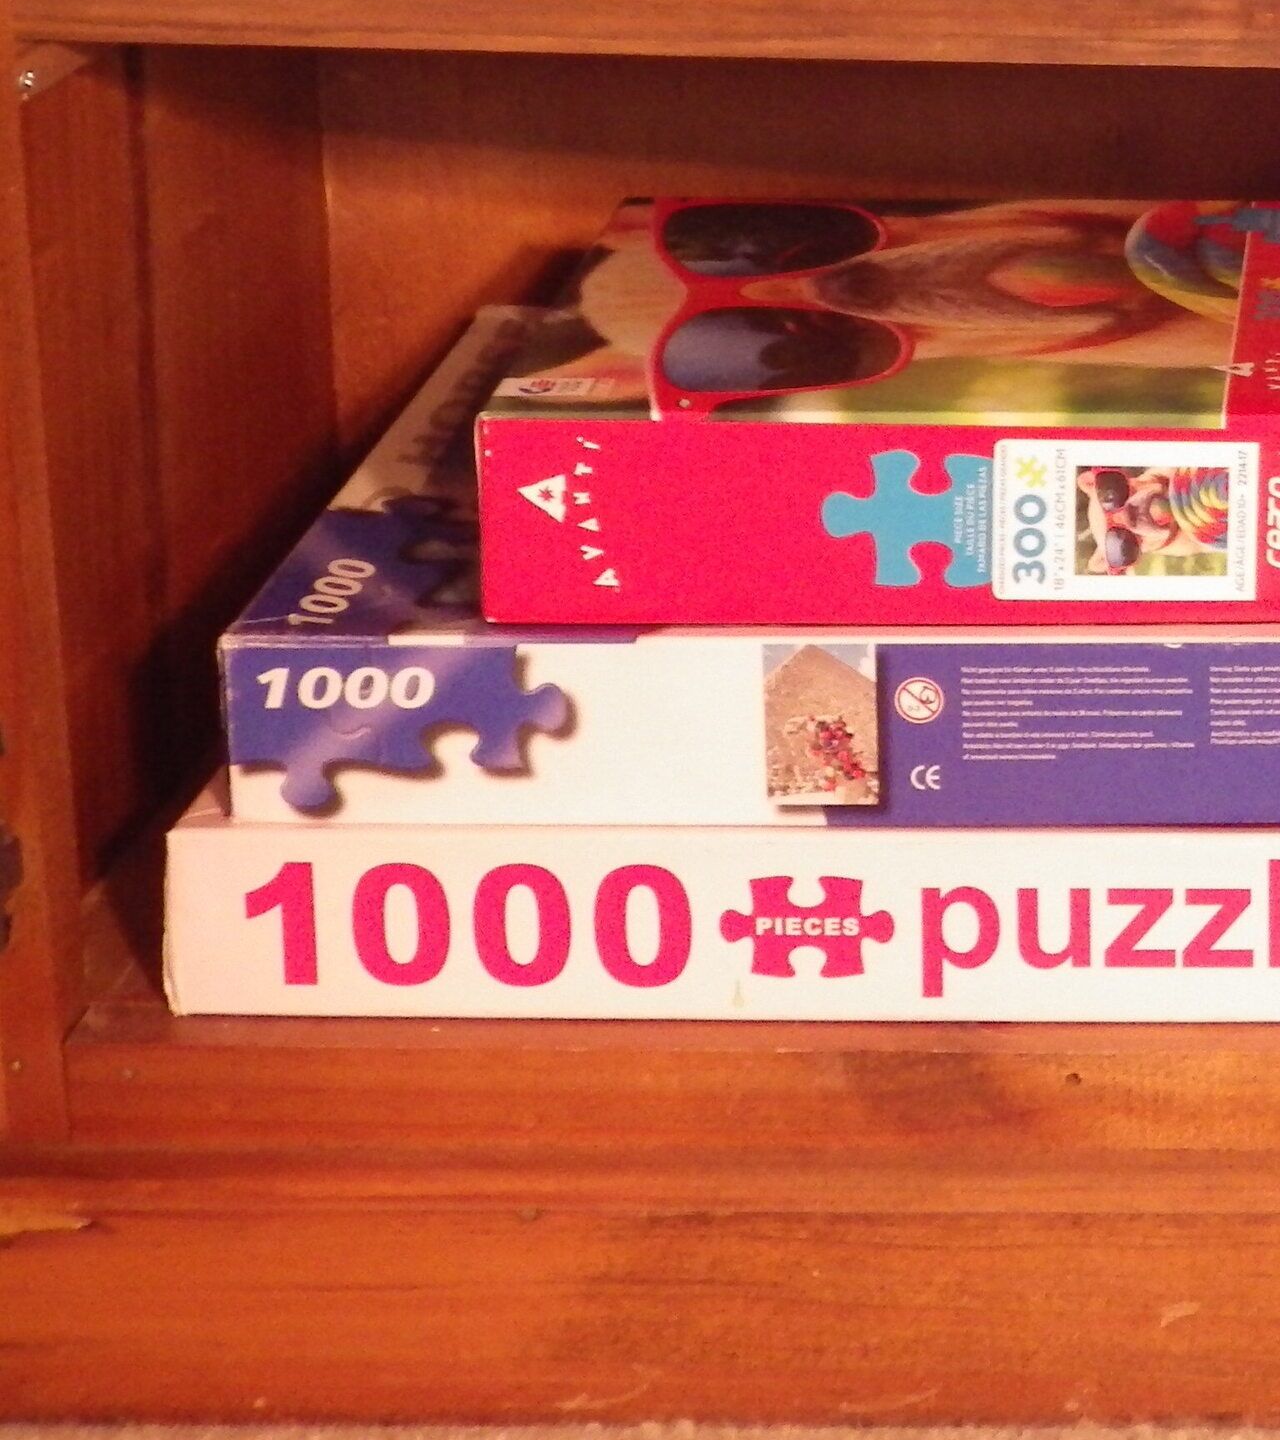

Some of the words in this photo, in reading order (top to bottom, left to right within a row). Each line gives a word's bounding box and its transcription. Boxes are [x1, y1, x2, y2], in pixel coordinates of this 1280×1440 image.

[1012, 494, 1047, 584] 300
[288, 558, 377, 628] 1000
[256, 666, 436, 710] 1000
[243, 860, 691, 987] 1000
[754, 916, 861, 937] PIECES
